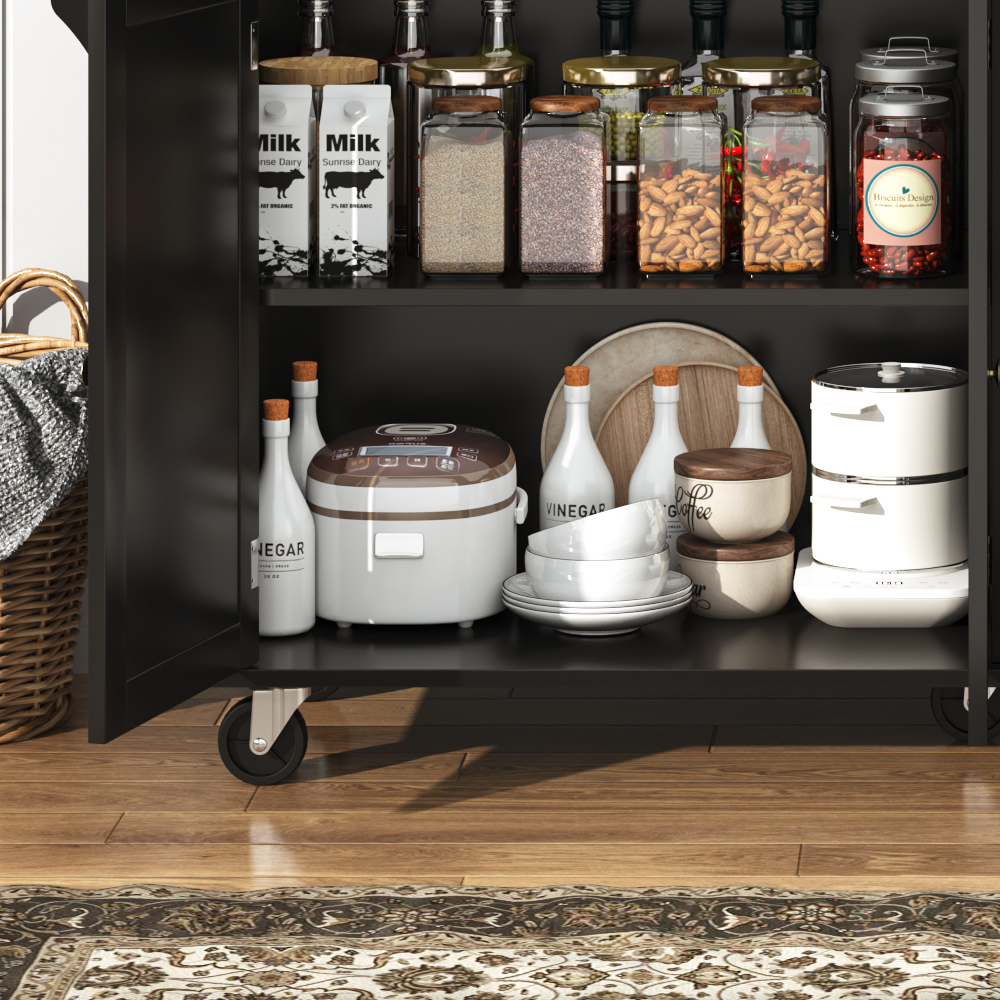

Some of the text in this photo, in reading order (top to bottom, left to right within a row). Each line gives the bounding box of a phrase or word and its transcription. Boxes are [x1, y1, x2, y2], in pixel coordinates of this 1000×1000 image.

[326, 134, 381, 152] Milk
[279, 158, 302, 168] Dairy
[322, 158, 381, 167] Sunrise Dairy
[873, 193, 934, 203] Biscuits Design
[546, 502, 606, 517] VINEGAR
